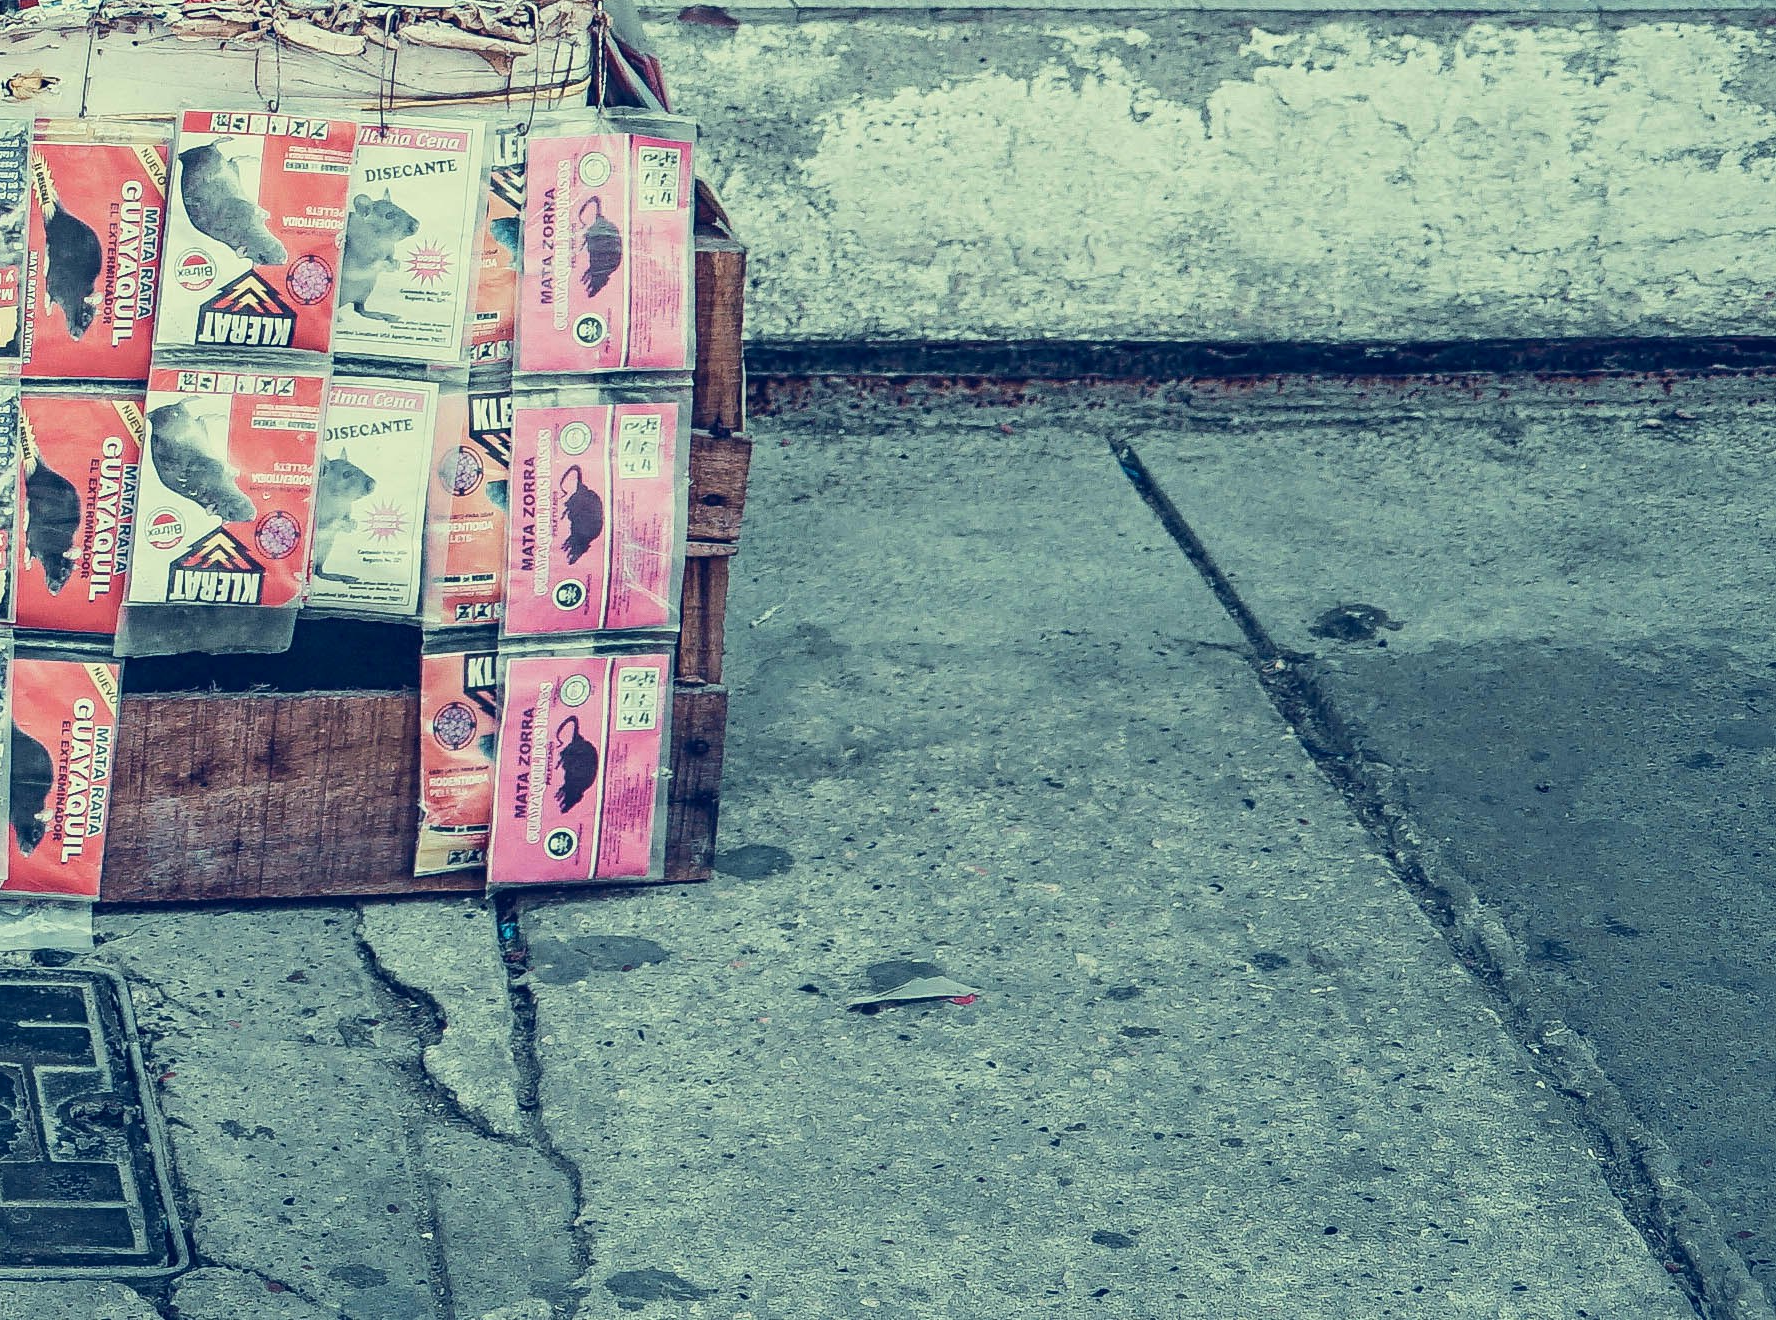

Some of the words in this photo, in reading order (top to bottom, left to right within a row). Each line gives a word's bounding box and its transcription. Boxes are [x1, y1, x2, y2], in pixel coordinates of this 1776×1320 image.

[141, 146, 167, 188] NUEVO
[415, 132, 461, 151] Cena
[364, 158, 458, 183] DISECANTE
[142, 207, 160, 263] MATA
[542, 187, 556, 254] ZORRA
[103, 221, 118, 325] EXTERMINADOR
[111, 180, 144, 347] GUAYAQUIL
[177, 265, 213, 279] Bitrex
[540, 257, 554, 305] MATA
[137, 266, 157, 321] RATA
[199, 311, 293, 347] KLERAT
[372, 391, 418, 410] Cena
[120, 463, 140, 521] MATA
[522, 456, 536, 520] ZORRA
[80, 477, 97, 580] EXTERMINADOR
[88, 436, 125, 602] GUAYAQUIL
[147, 522, 183, 538] Bitrex
[521, 522, 534, 571] MATA
[114, 522, 133, 577] RATA
[170, 569, 261, 604] KLERAT
[92, 665, 119, 706] NUEVO
[93, 725, 111, 781] MATA
[518, 707, 536, 770] ZORRA
[51, 739, 70, 842] EXTERMINADOR
[59, 697, 96, 865] GUAYAQUIL
[513, 773, 529, 820] MATA
[87, 783, 106, 839] RATA
